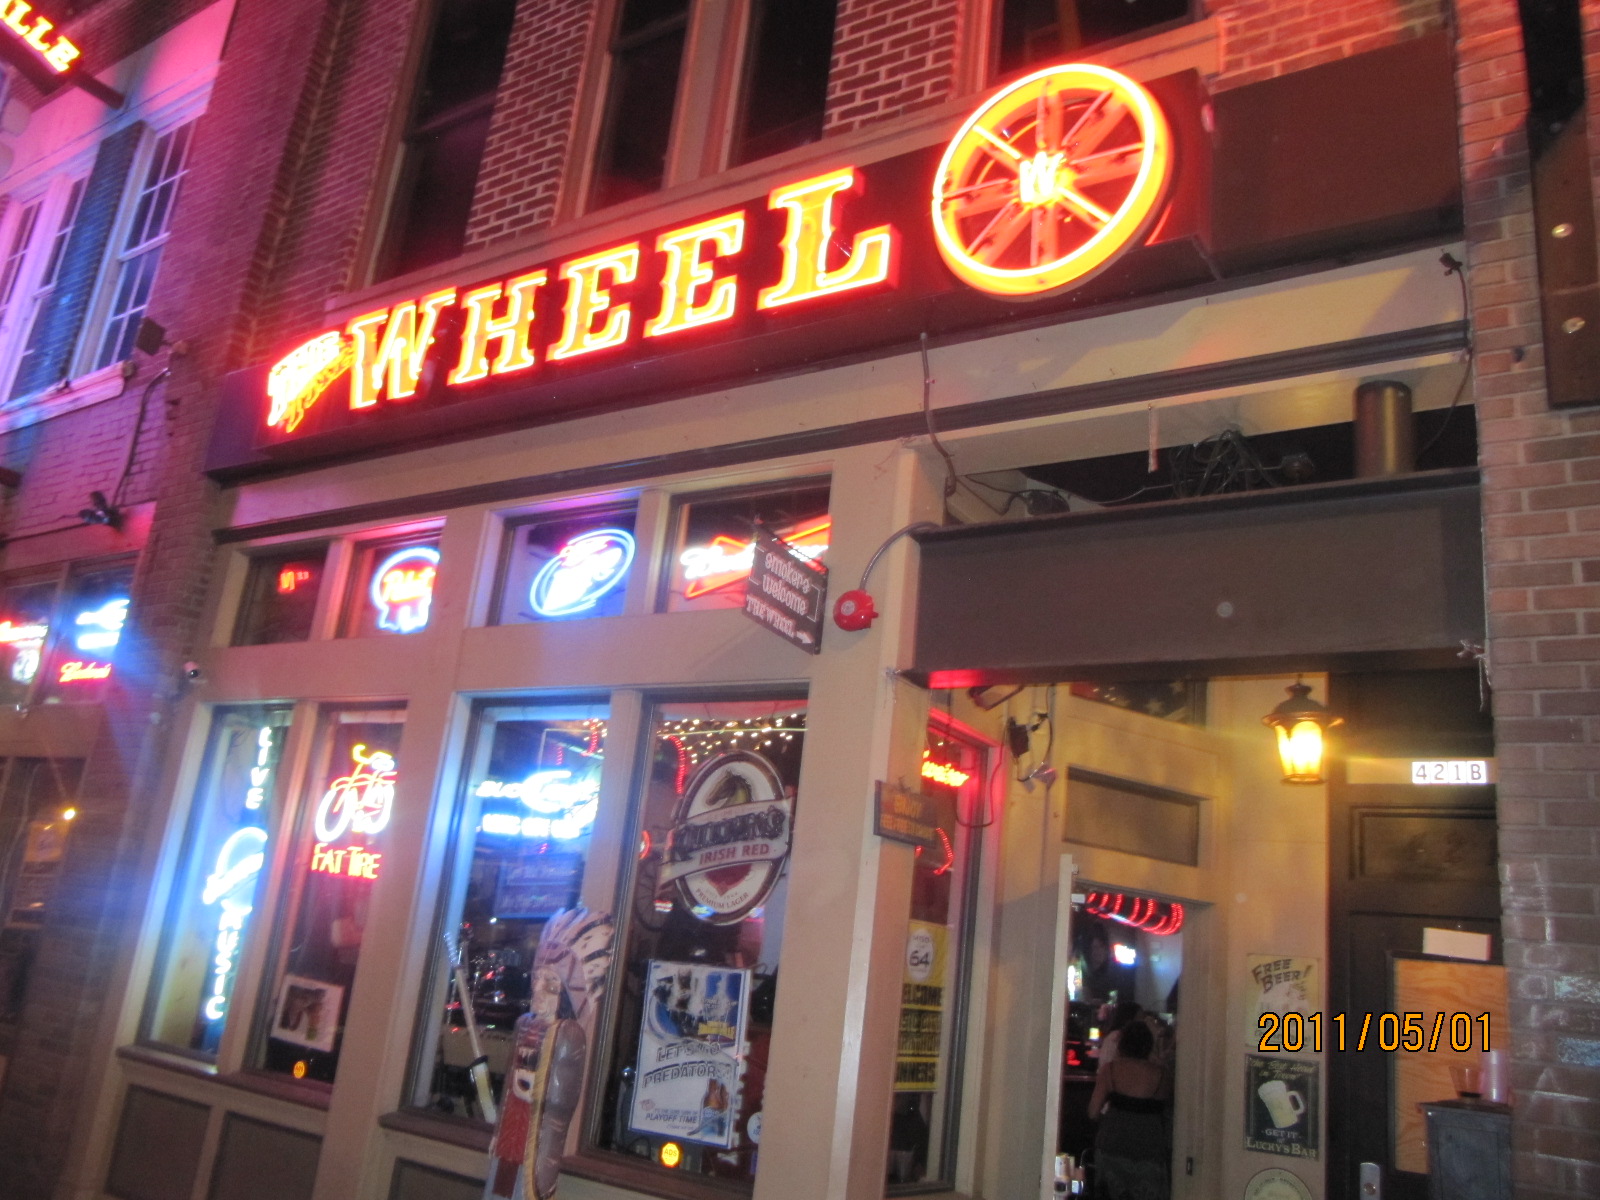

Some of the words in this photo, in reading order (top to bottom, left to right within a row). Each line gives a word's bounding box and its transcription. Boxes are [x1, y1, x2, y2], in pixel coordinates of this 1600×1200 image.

[346, 165, 894, 410] WHEEL
[246, 726, 272, 810] LIVE
[1415, 764, 1482, 781] 421B
[311, 843, 347, 874] FAT
[699, 847, 736, 866] IRISH
[742, 843, 770, 857] RED
[727, 891, 749, 908] LAGER
[909, 949, 930, 967] 64
[1252, 959, 1292, 984] FREE
[646, 1112, 678, 1123] PLAYOFF
[678, 1115, 697, 1124] TIME
